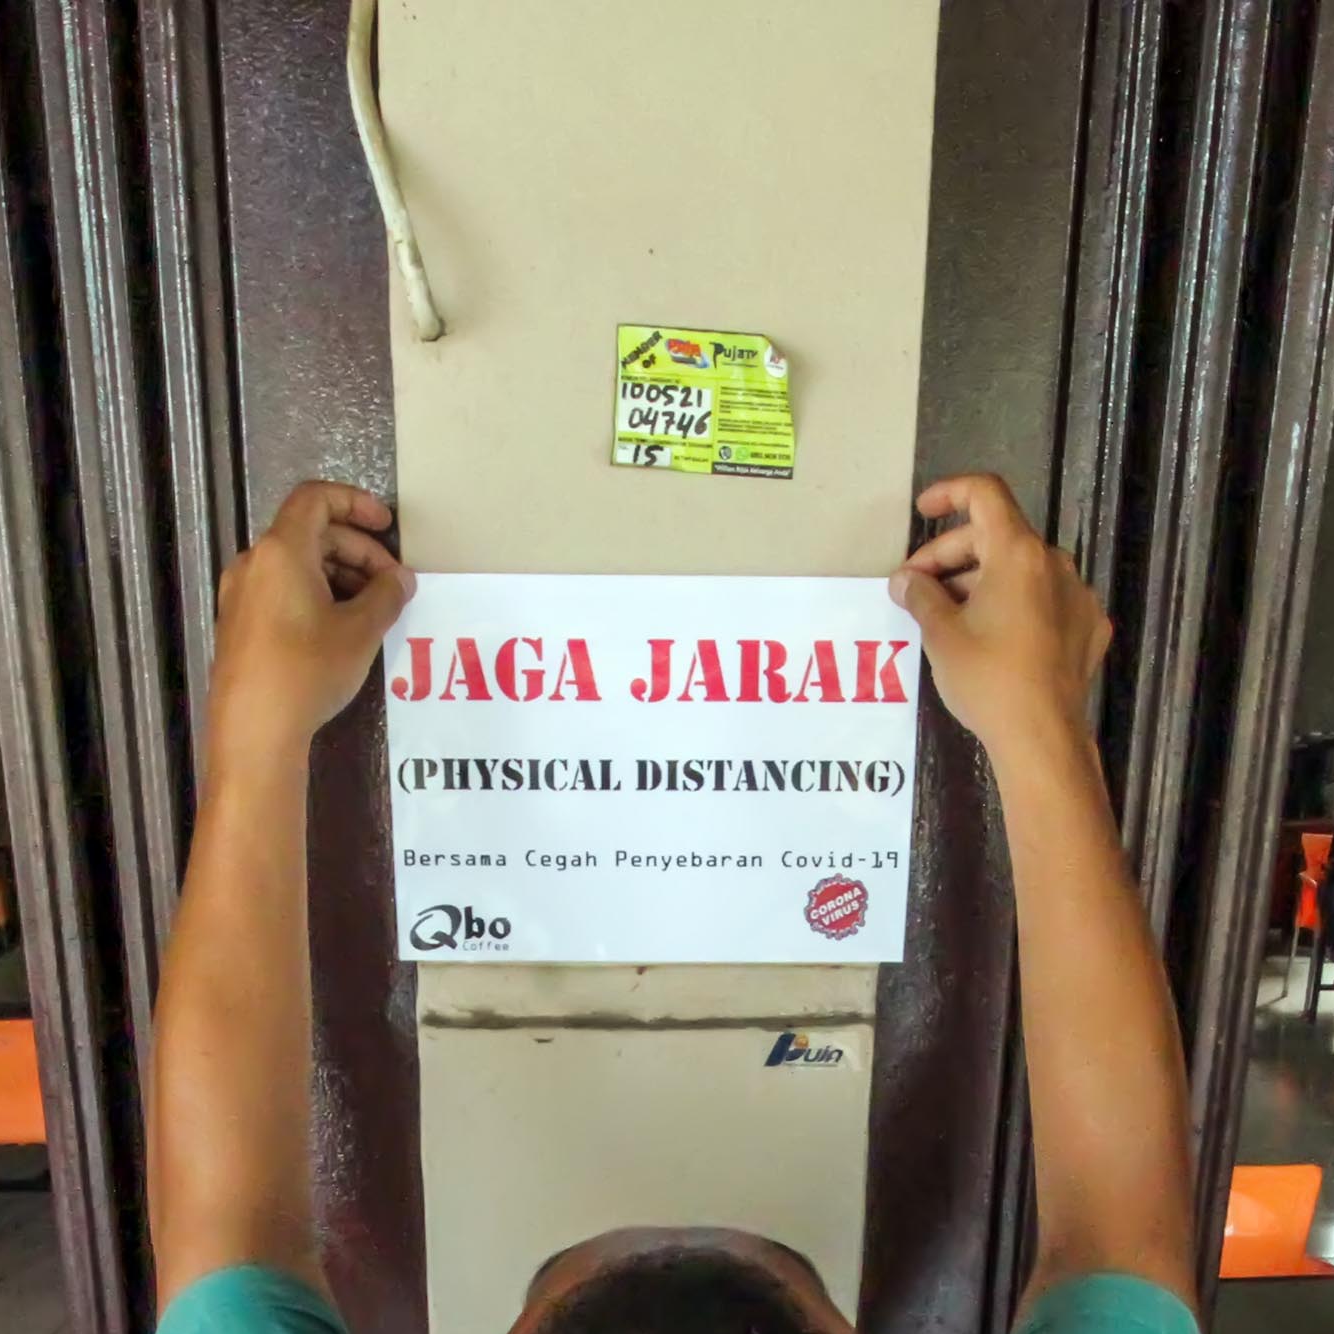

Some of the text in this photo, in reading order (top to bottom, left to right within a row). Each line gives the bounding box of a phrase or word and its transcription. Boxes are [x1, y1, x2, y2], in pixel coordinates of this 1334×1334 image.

[628, 406, 712, 439] 04746
[391, 636, 909, 704] JAGA JARAK
[396, 757, 906, 797] (PHYSICAL DISTANCING)
[403, 849, 899, 871] Bersama Cegah Penyebaran Covid-19
[810, 887, 862, 919] CORONA
[822, 900, 860, 926] VIRUS
[409, 904, 511, 951] Qbo
[462, 941, 510, 951] Coffee
